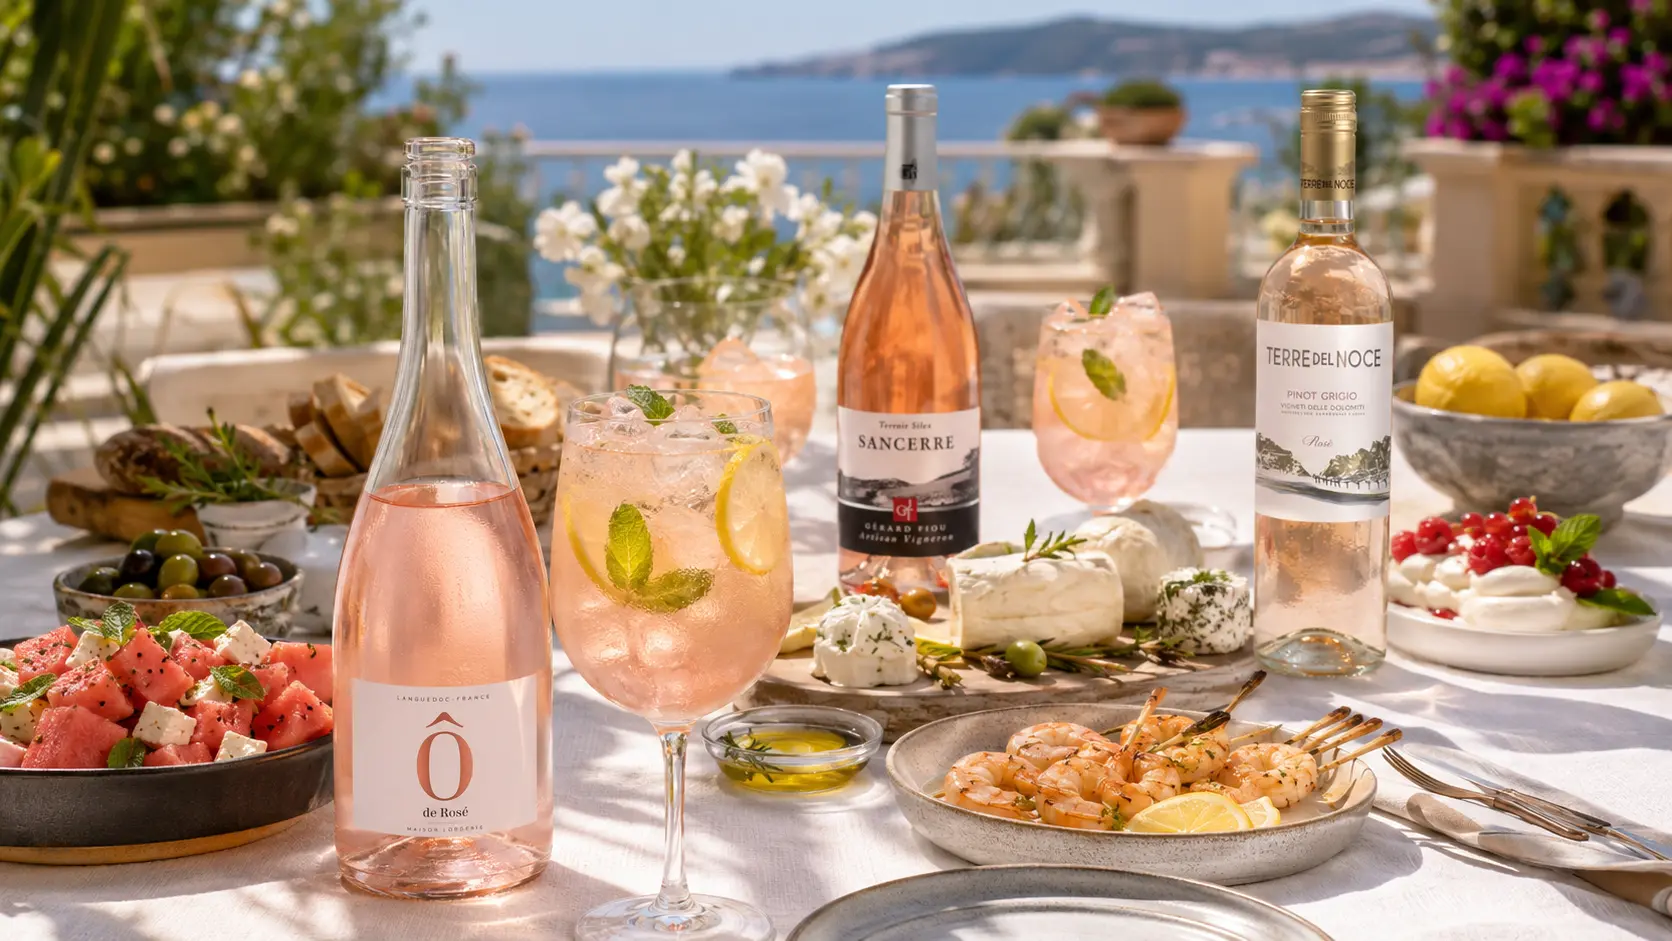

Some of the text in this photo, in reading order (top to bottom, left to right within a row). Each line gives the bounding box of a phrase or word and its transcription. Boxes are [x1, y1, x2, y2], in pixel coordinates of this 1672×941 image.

[1333, 179, 1355, 189] NOCE
[1266, 346, 1381, 368] TERRE DEL NOCE
[1287, 390, 1358, 401] PINOT GRIGIO
[858, 434, 955, 451] SANCERRE
[859, 531, 954, 546] Artisan Vigneron
[416, 711, 474, 801] Ô
[422, 806, 469, 818] de Rosé
